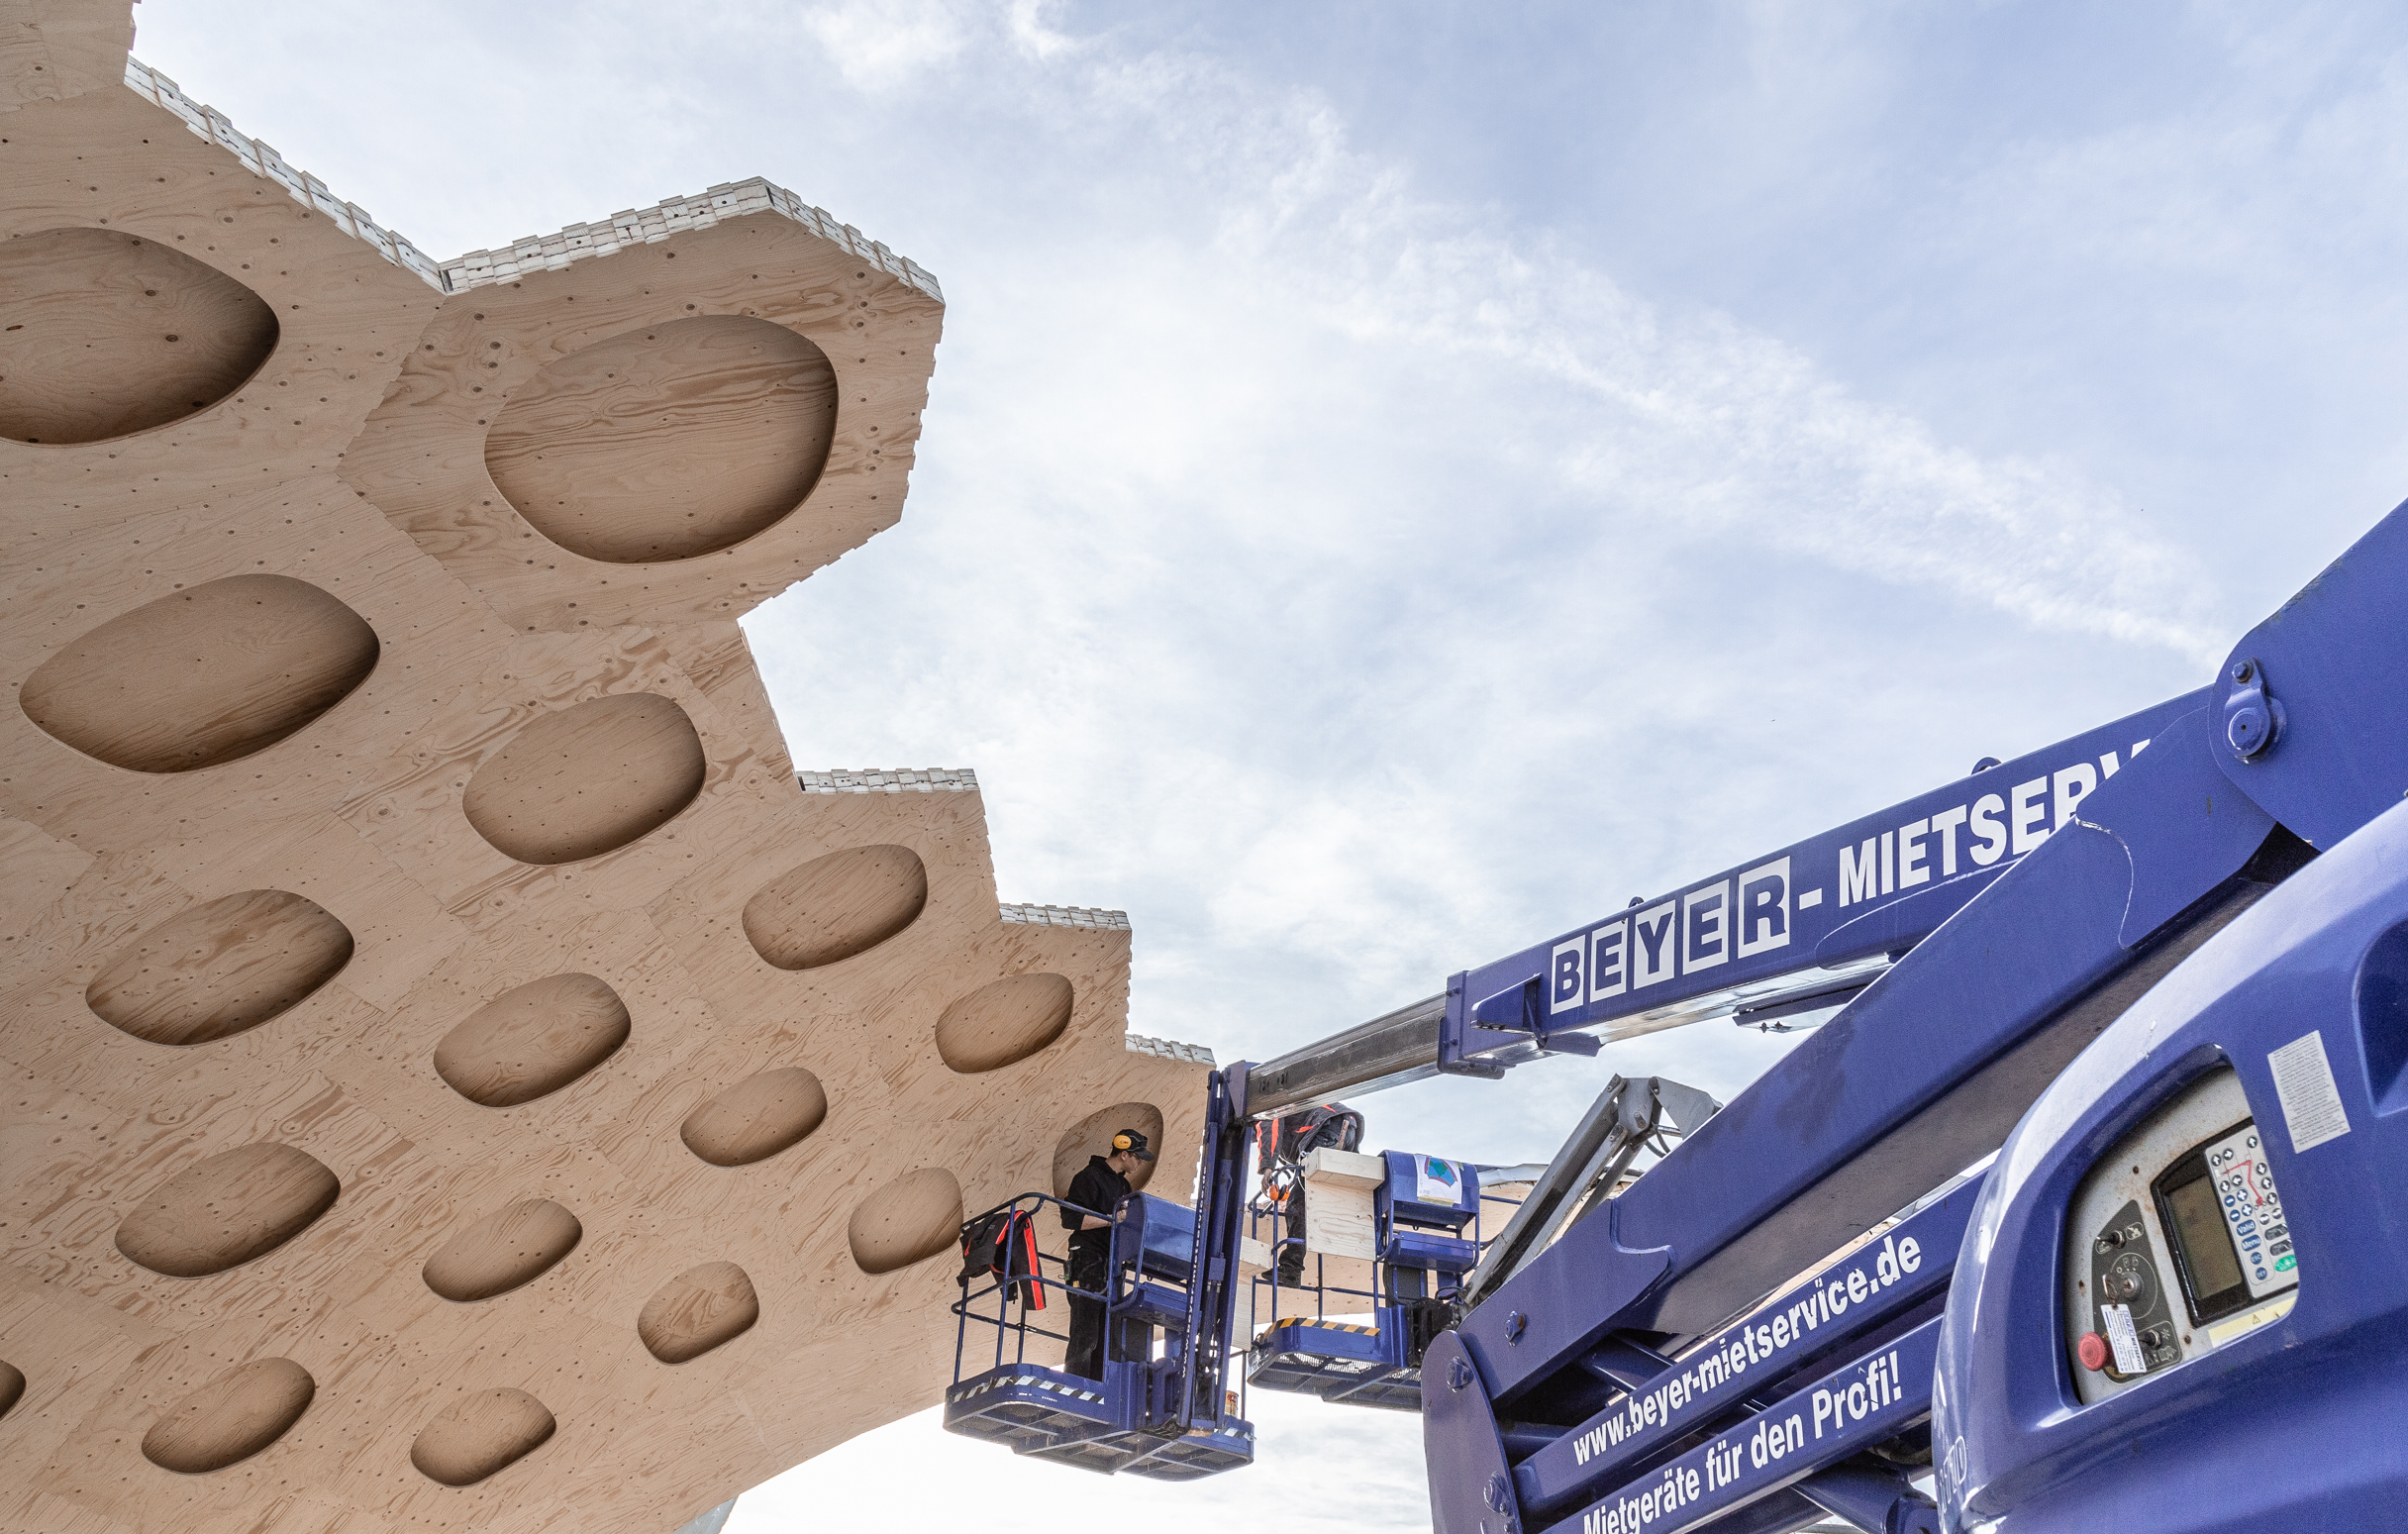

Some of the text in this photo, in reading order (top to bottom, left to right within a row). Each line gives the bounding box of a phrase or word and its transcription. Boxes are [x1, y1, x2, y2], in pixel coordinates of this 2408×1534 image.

[2237, 1219, 2257, 1235] Valid
[2241, 1237, 2261, 1251] Menu
[1572, 1234, 1922, 1467] www.beyer-mietservice.de
[1583, 1350, 1903, 1534] Mietgeräte für den Profi!
